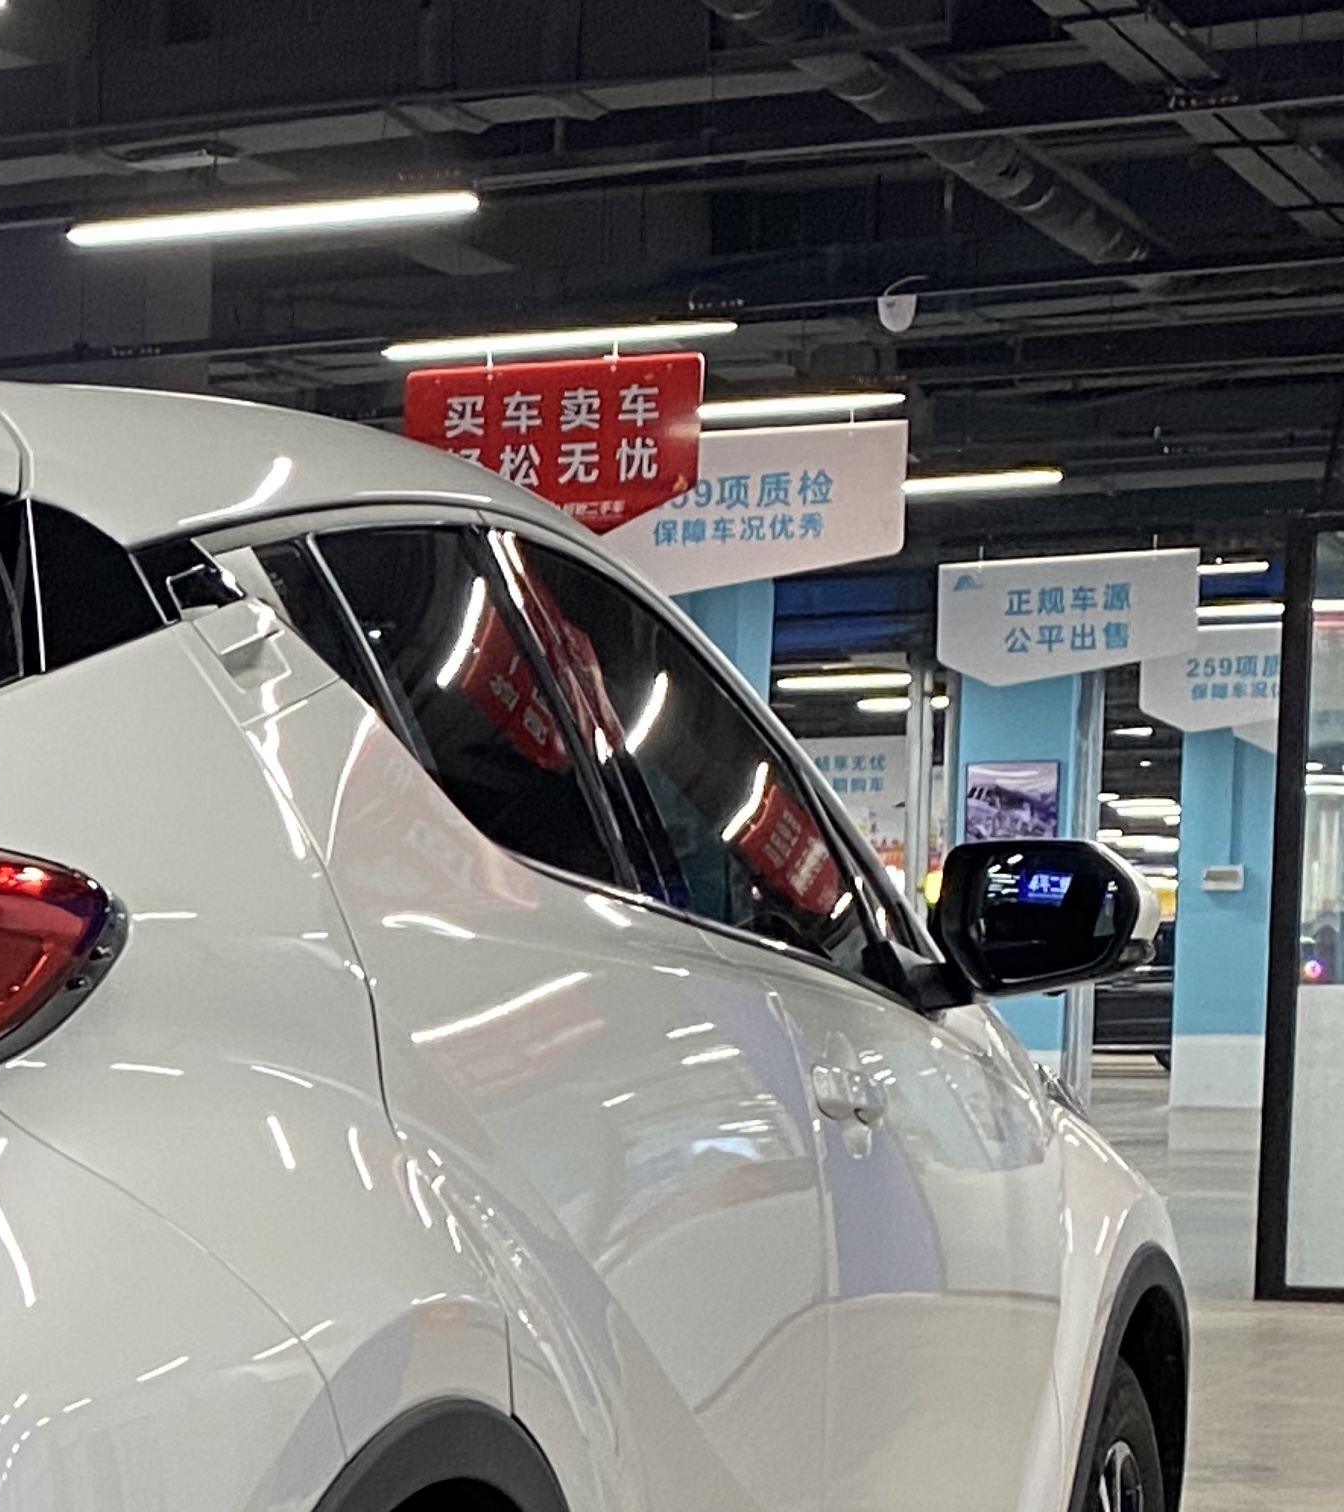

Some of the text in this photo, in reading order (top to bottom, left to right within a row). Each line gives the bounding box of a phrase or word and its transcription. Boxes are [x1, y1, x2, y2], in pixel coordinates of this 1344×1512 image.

[444, 383, 660, 440] 买车卖车
[662, 468, 834, 511] 9项质检
[653, 511, 825, 547] 保障车况优秀
[1004, 582, 1132, 617] 正规车源
[1004, 622, 1130, 654] 公平出售
